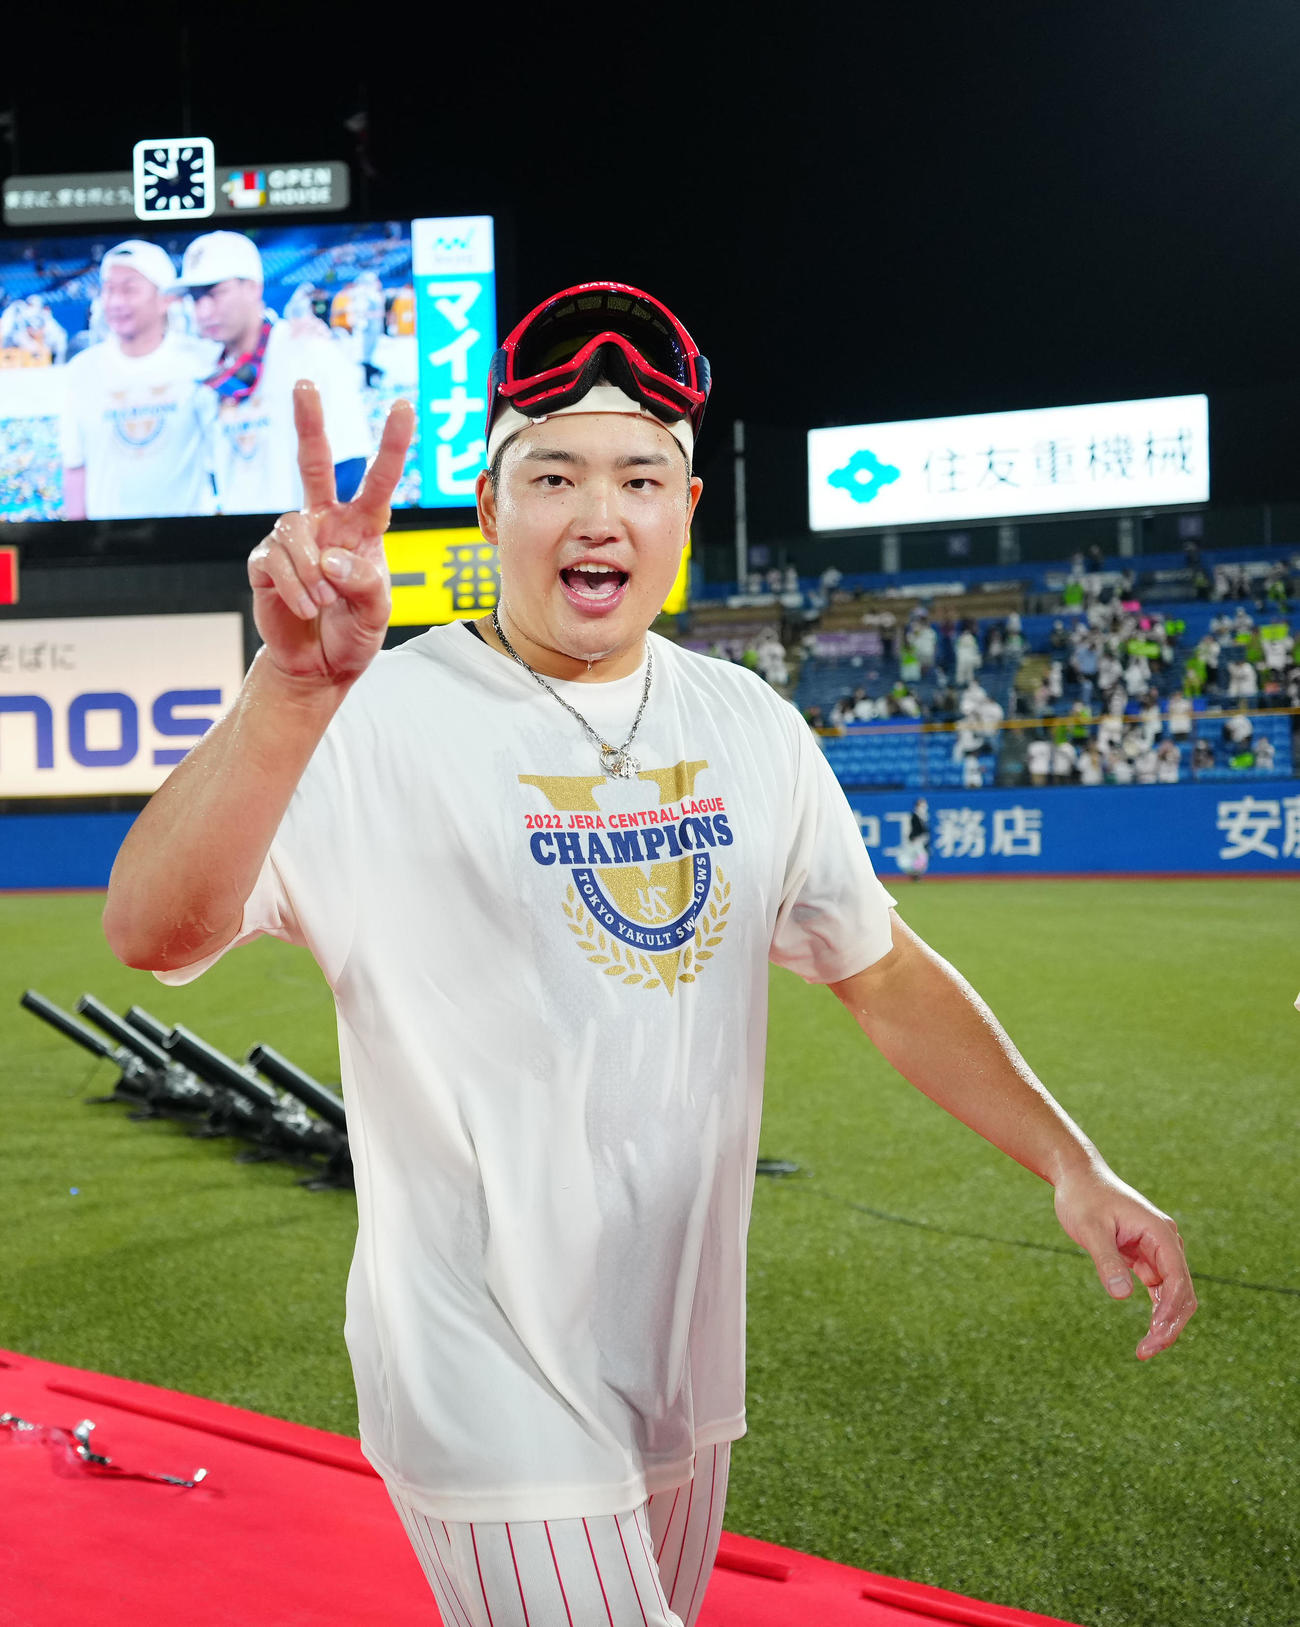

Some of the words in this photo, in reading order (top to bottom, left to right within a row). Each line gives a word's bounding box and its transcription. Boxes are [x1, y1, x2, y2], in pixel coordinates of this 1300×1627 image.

[427, 281, 488, 495] マイナビ
[922, 427, 1194, 495] 住友重機械
[524, 814, 563, 830] 2022
[567, 814, 606, 830] JERA
[608, 806, 680, 829] CENTRAL
[680, 797, 726, 816] LAGUE
[529, 813, 734, 866] CHAMPIONS
[1216, 794, 1300, 860] 安
[578, 872, 615, 925] TOKYO
[618, 919, 672, 946] YAKULT
[675, 856, 708, 939] SWLOWS
